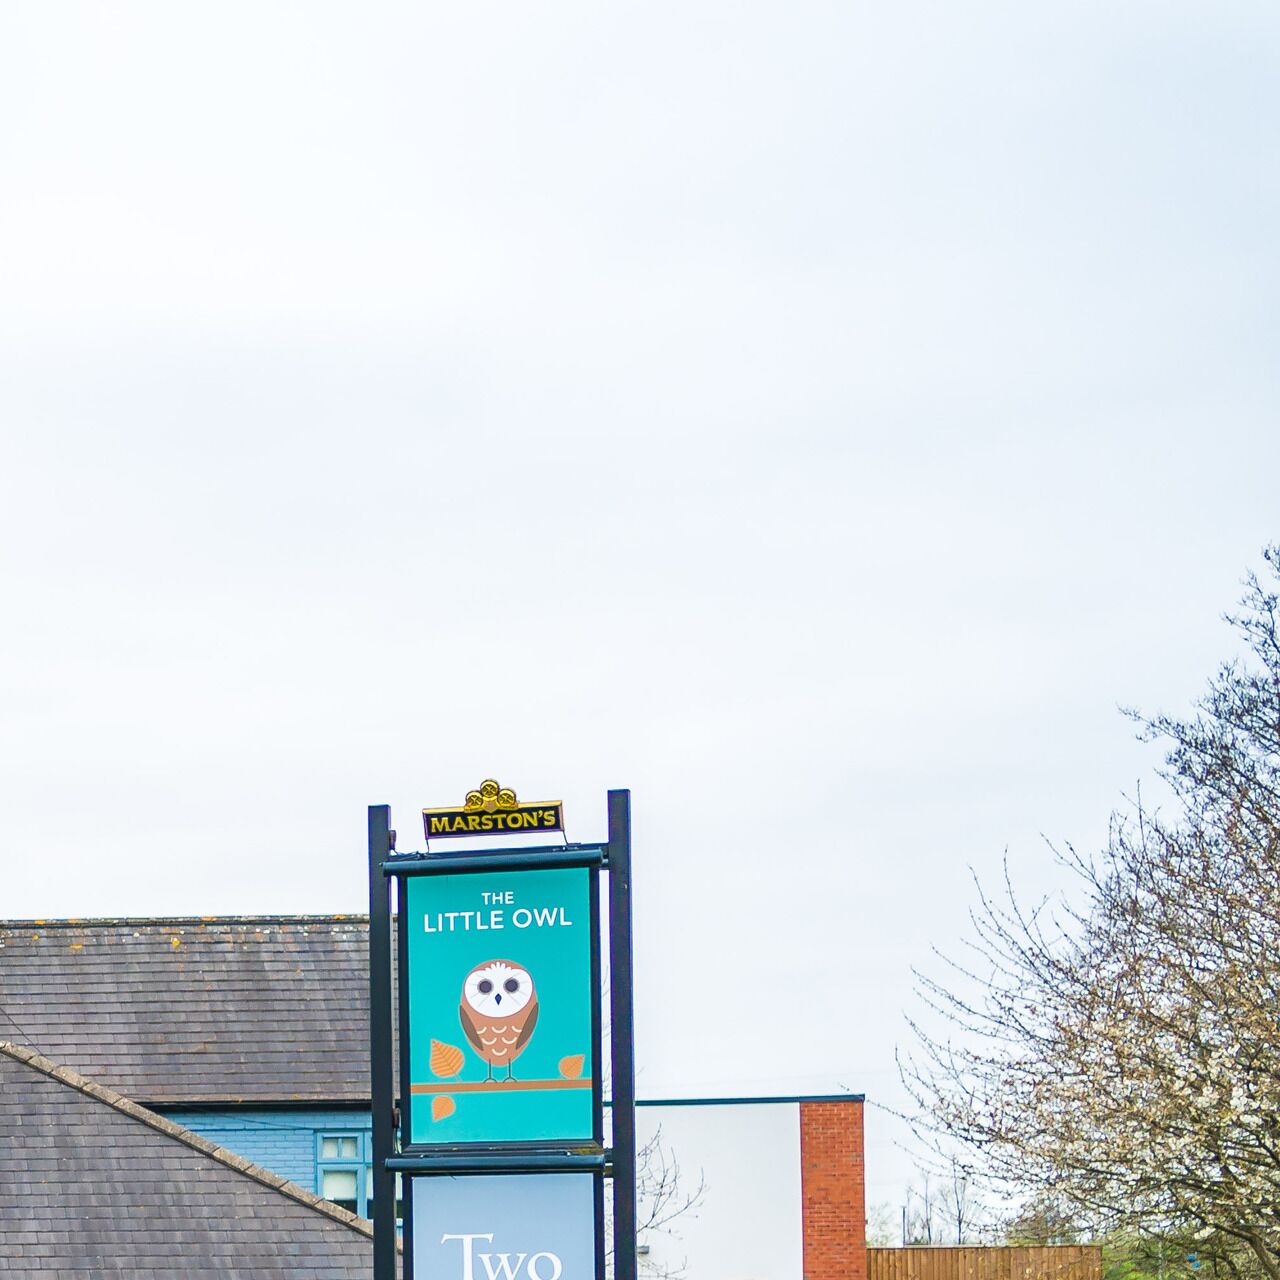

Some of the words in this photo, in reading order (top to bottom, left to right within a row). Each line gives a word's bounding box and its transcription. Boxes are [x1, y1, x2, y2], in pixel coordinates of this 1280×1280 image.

[430, 810, 556, 833] MARSTON'S
[481, 891, 515, 905] THE
[424, 910, 504, 933] LITTLE
[512, 907, 573, 929] OWL
